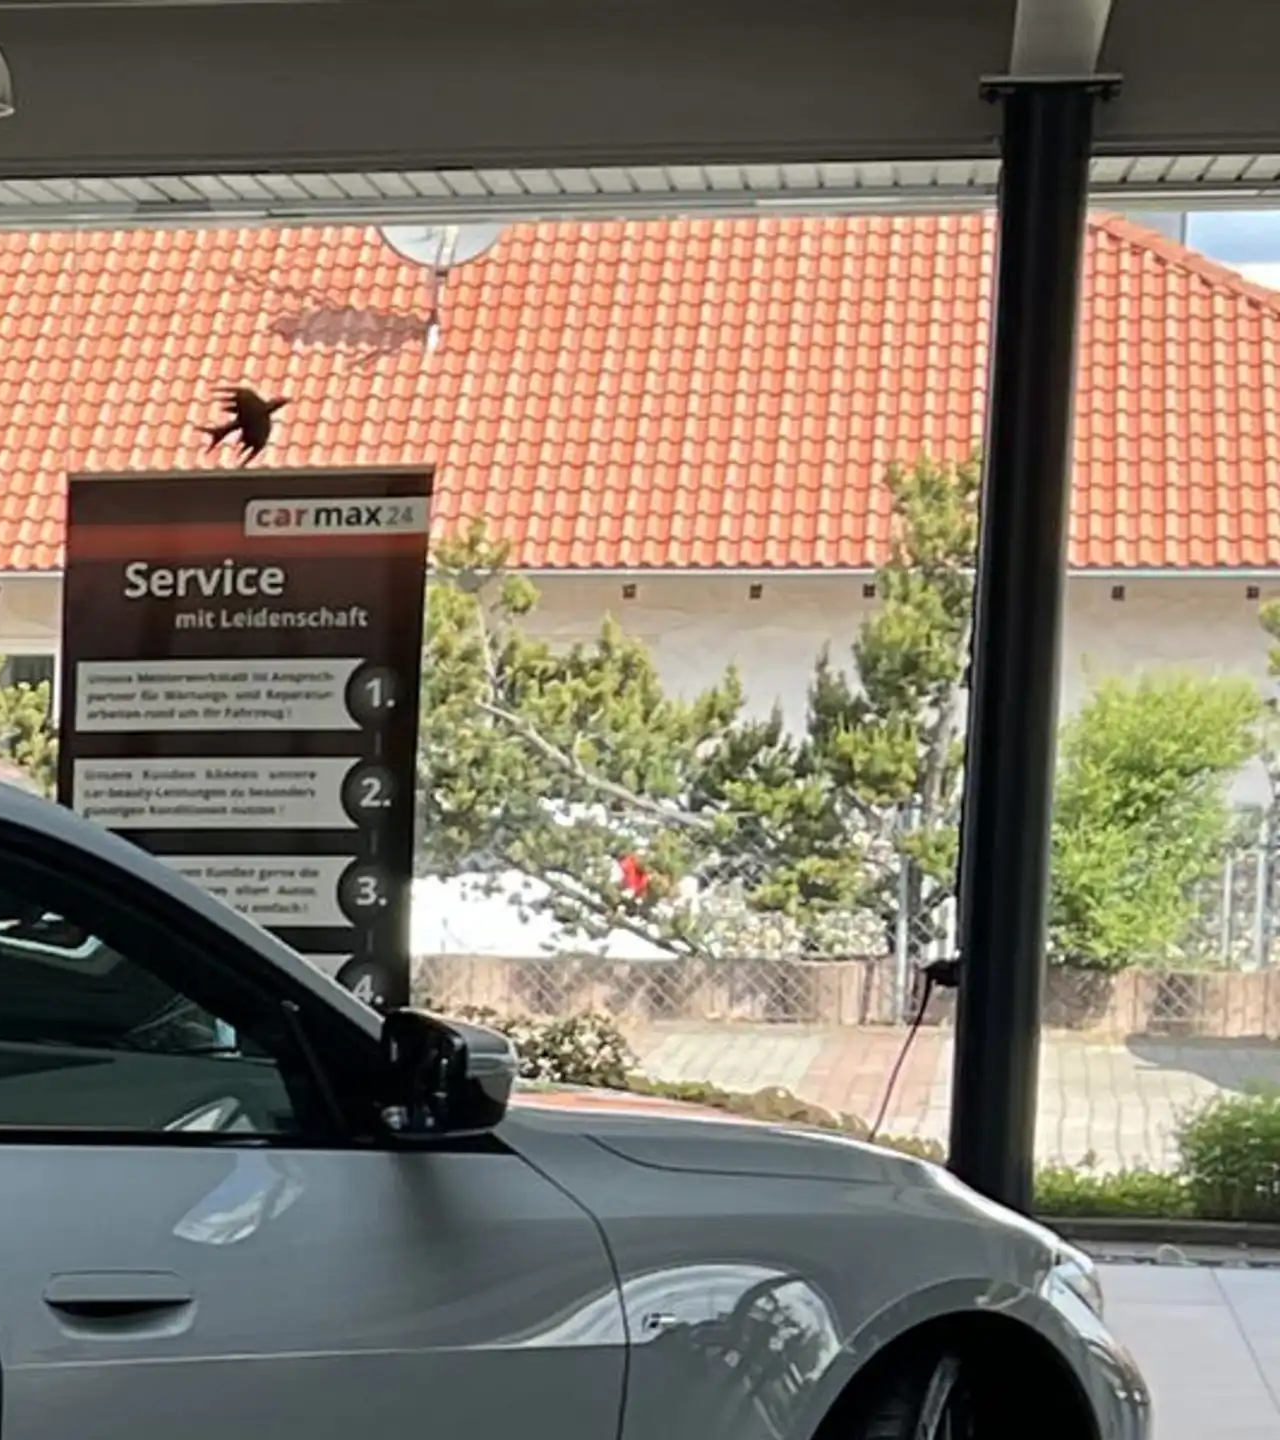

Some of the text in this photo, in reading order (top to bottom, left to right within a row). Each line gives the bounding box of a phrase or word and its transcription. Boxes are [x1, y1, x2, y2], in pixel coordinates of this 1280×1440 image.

[124, 559, 285, 597] Service
[175, 606, 368, 628] mit Leidenschaft
[366, 678, 395, 707] 1.
[360, 778, 391, 807] 2.
[355, 876, 387, 906] 3.
[352, 975, 383, 1005] 4.
